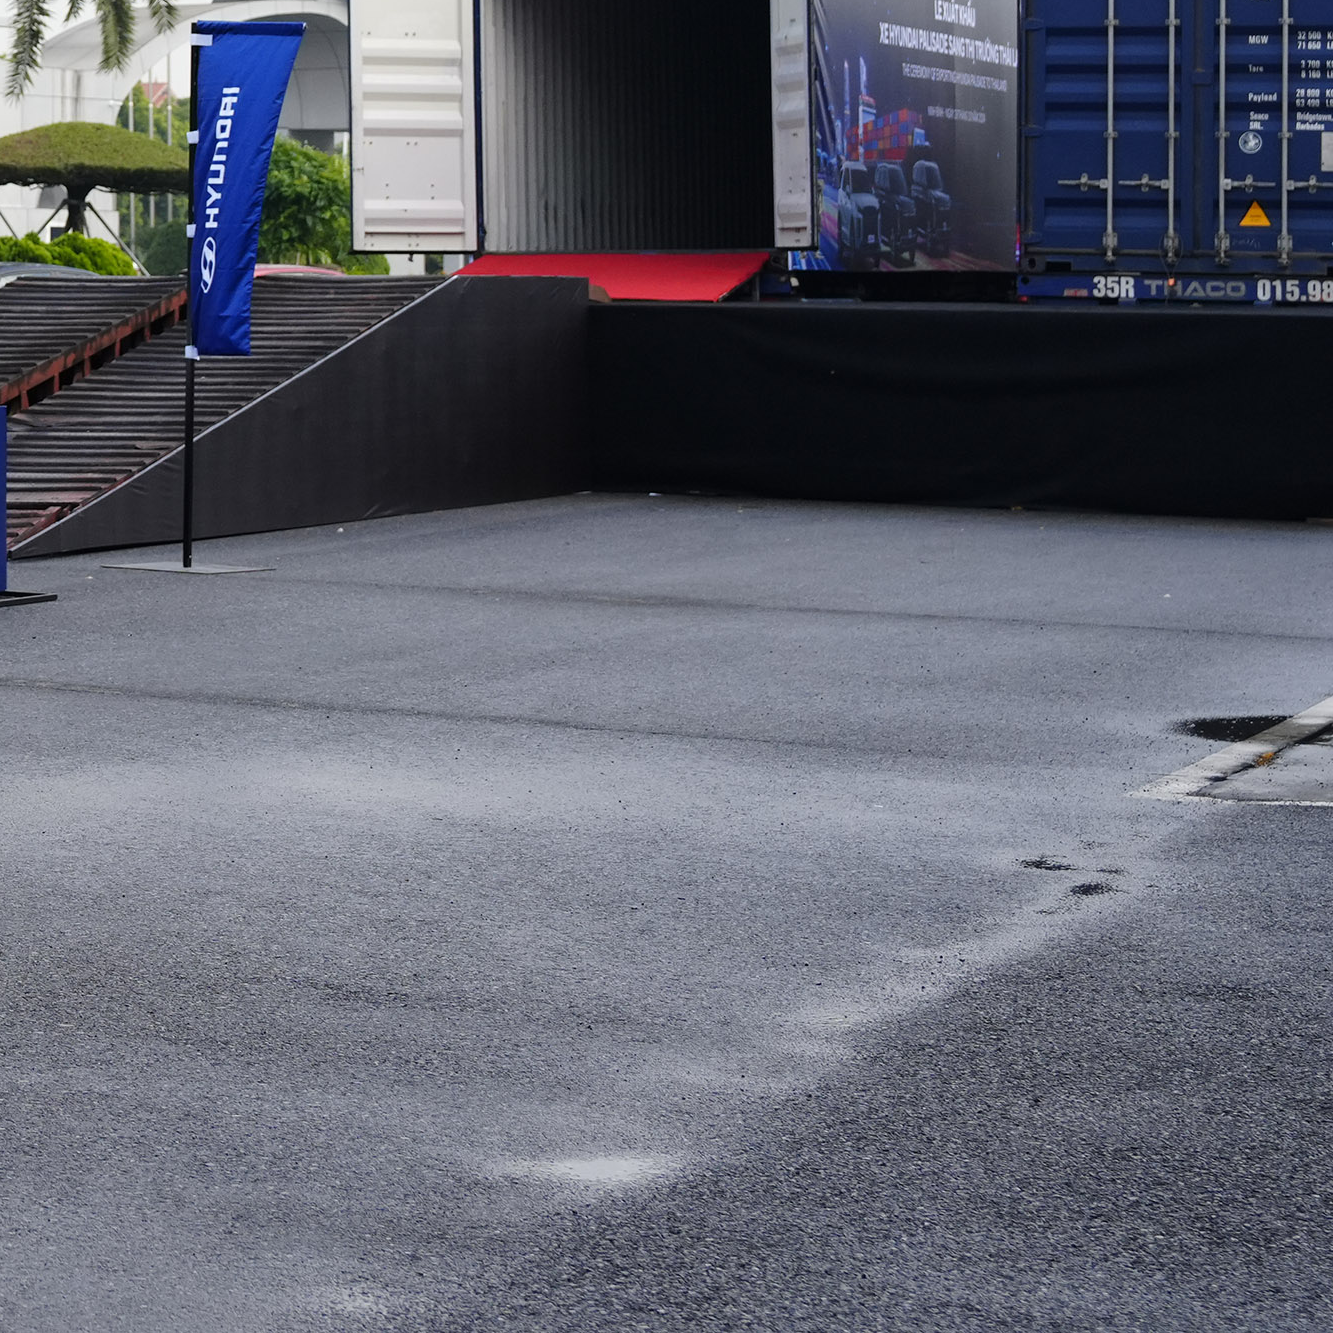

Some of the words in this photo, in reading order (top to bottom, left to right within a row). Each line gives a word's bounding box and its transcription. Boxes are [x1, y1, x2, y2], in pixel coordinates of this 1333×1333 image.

[889, 23, 919, 49] HYUNDAI
[918, 28, 948, 55] PALISADE
[1248, 35, 1269, 45] MGW
[1248, 92, 1278, 103] Payload
[205, 86, 241, 229] HYUNDAI
[1093, 275, 1135, 298] 35R
[1144, 279, 1246, 298] THACO
[1256, 278, 1333, 302] 015.98
